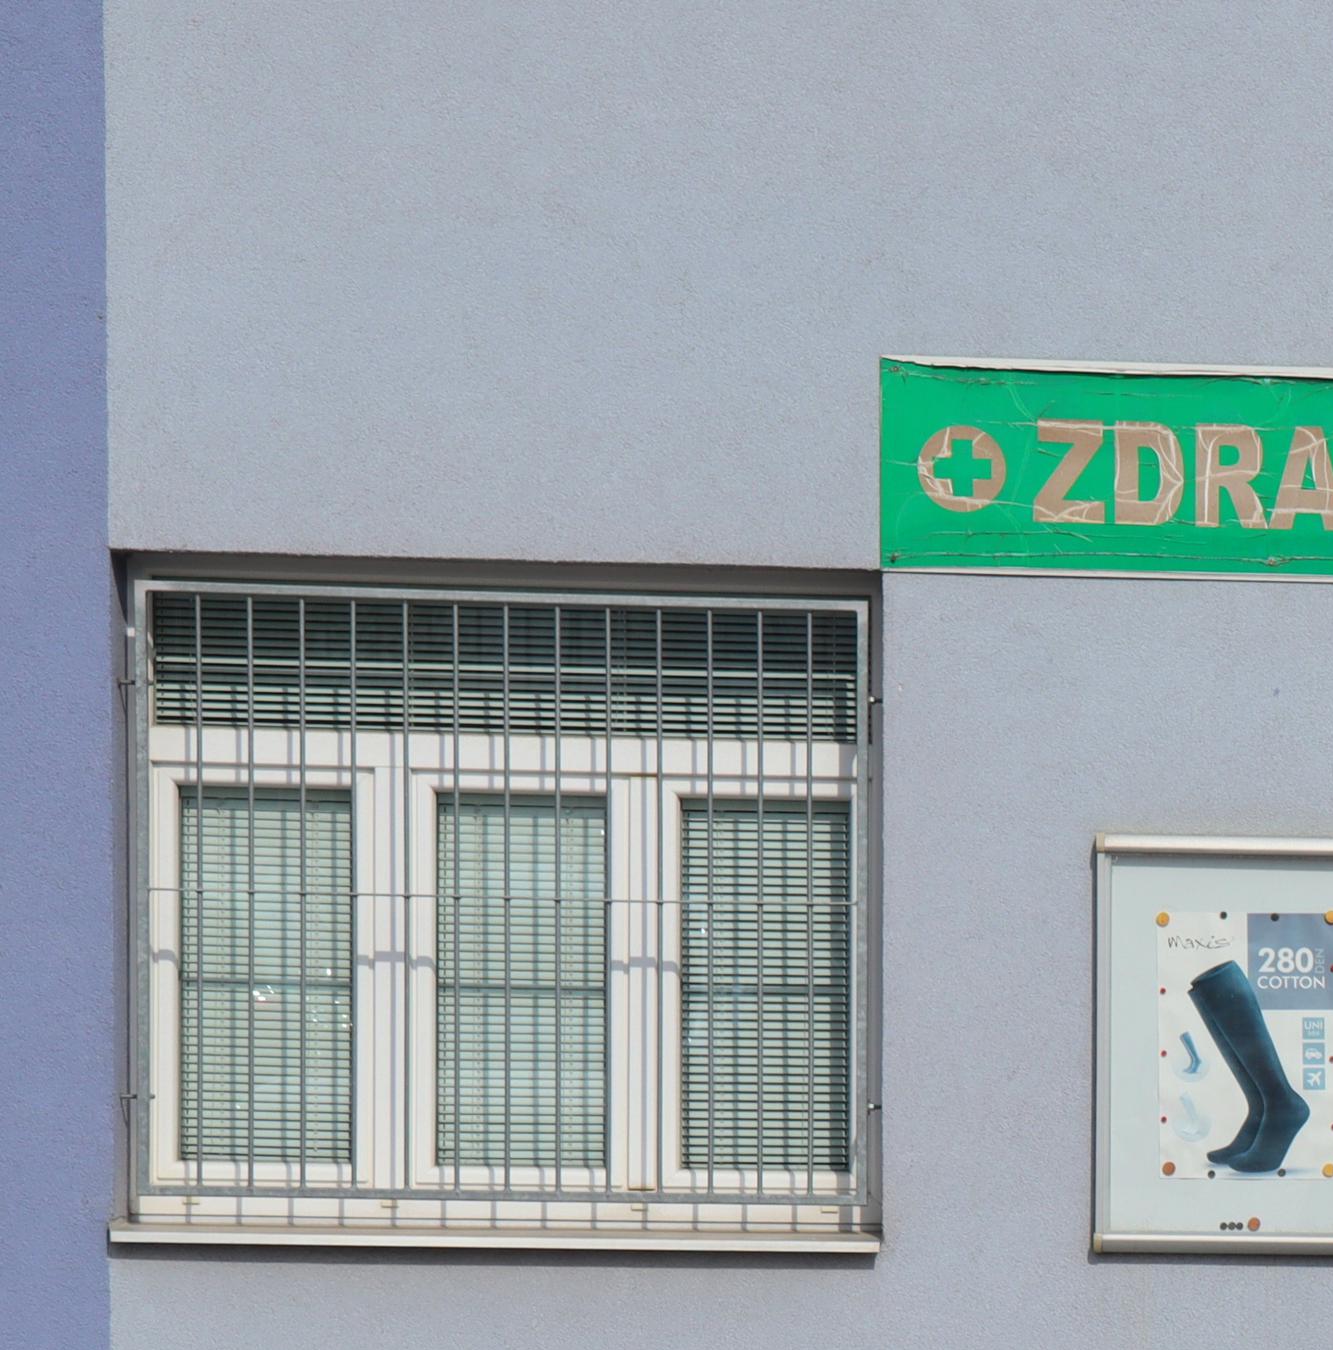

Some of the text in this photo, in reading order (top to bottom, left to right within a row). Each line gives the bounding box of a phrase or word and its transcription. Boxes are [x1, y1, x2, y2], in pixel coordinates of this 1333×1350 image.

[1257, 946, 1314, 974] 280
[1314, 948, 1326, 974] DEN
[1257, 975, 1326, 989] COTTON
